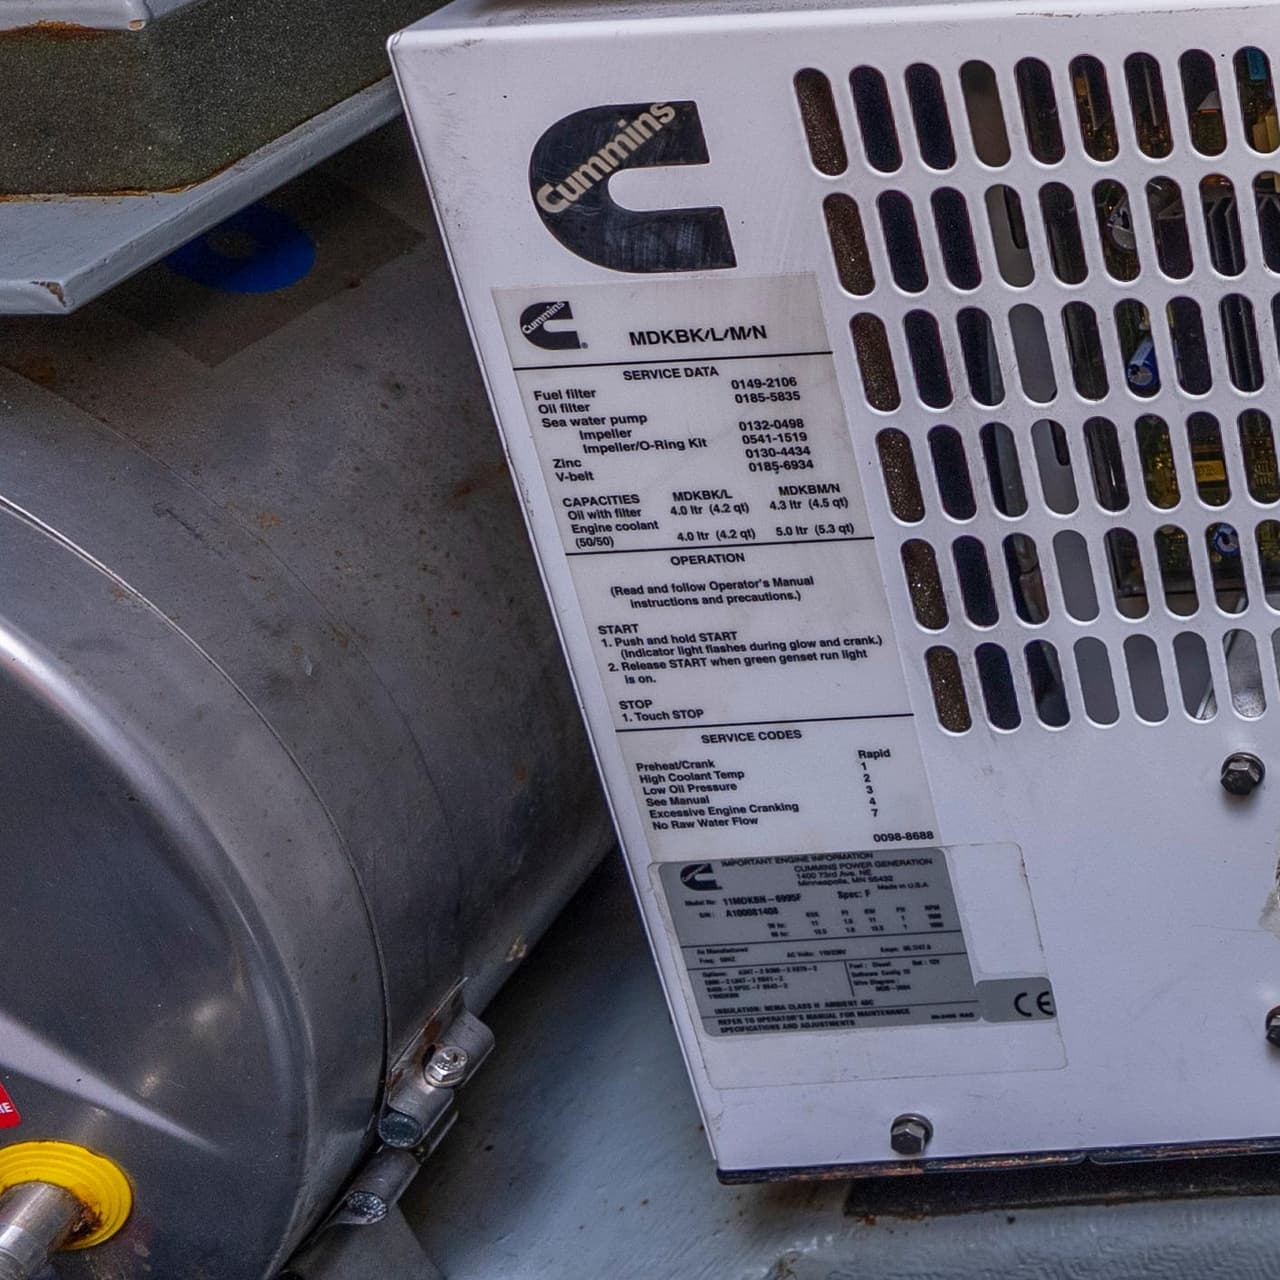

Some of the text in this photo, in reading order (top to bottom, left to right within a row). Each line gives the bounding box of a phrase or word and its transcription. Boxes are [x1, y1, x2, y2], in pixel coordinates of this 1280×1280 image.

[536, 101, 676, 214] Cummins
[522, 301, 565, 334] Cummins
[628, 324, 767, 346] MDKBK/L/M/N
[622, 365, 719, 381] SERVICE DATA
[730, 376, 797, 390] 0149-2106
[533, 388, 596, 401] Fuel filter
[734, 390, 801, 404] 0185-5835
[537, 402, 590, 414] Oil filter
[541, 414, 648, 428] Sea water pump
[738, 418, 804, 431] 0132-0498
[578, 428, 632, 441] Impeller
[741, 431, 807, 444] 0541-1519
[582, 437, 707, 455] Impeller/O-Ring Kit
[745, 445, 811, 458] 0130-4434
[552, 458, 582, 469] Zinc
[748, 459, 814, 473] 0185-6934
[555, 470, 594, 482] V-belt
[672, 489, 733, 502] MDKBK/L
[778, 483, 840, 496] MDKBM/N
[562, 493, 640, 507] CAPACITIES
[769, 496, 848, 510] 4.3 ltr (4.5 qt)
[567, 507, 641, 520] Oil with filter
[670, 501, 749, 516] 4.0 ltr (4.2 qt)
[570, 520, 659, 536] Engine coolant
[575, 535, 614, 549] (50/50)
[670, 552, 745, 566] OPERATION
[610, 584, 645, 598] (Read
[646, 583, 669, 594] and
[670, 582, 706, 593] follow
[771, 575, 814, 587] Manual
[701, 594, 724, 605] and
[597, 623, 638, 635] START
[601, 631, 737, 647] 1. Push and hold START
[676, 645, 704, 657] light
[704, 643, 747, 654] flashes
[749, 641, 787, 652] during
[789, 639, 816, 651] glow
[819, 637, 841, 647] and
[842, 634, 882, 650] crank.)
[607, 648, 868, 672] 2. Release START when green genset run light
[624, 674, 656, 684] is on.
[618, 699, 653, 710] STOP
[621, 708, 704, 722] 1. Touch STOP
[700, 729, 802, 744] SERVICE CODES
[857, 748, 891, 760] Rapid
[635, 759, 715, 772] Preheat/Crank
[638, 770, 745, 785] High Coolant Temp
[642, 783, 737, 795] Low Oil Pressure
[645, 794, 710, 807] See Manual
[648, 802, 799, 819] Excessive Engine Cranking
[651, 816, 758, 830] No Raw Water Flow
[872, 830, 934, 842] 0098-8688
[1013, 991, 1054, 1016] CE
